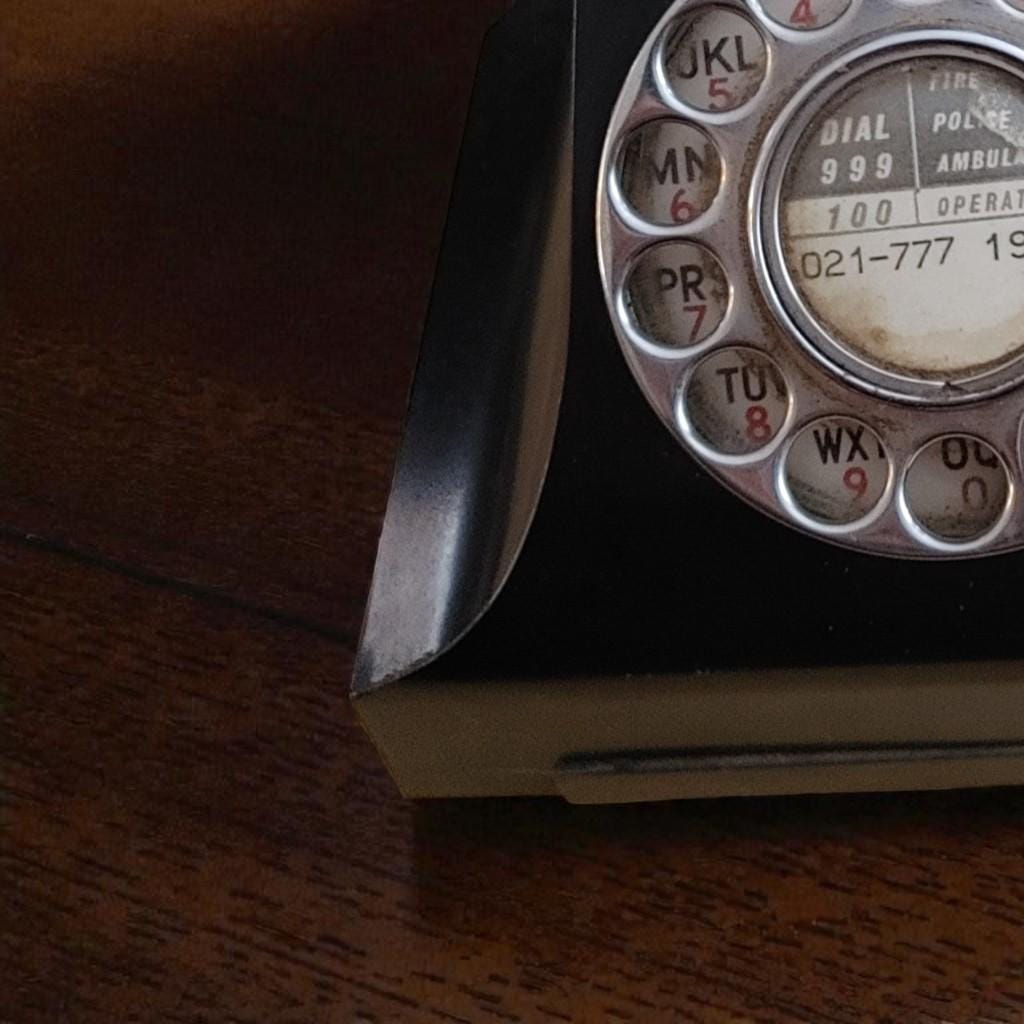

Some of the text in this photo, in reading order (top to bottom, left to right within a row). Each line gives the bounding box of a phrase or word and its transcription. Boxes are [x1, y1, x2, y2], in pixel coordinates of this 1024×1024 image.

[676, 35, 758, 79] JKL
[708, 78, 734, 110] 5
[929, 71, 978, 92] FIRE
[820, 113, 890, 146] DIAL
[820, 152, 893, 185] 999
[670, 188, 700, 224] 6
[828, 199, 892, 230] 100
[801, 236, 955, 280] 021-777
[683, 304, 707, 342] 7
[746, 405, 772, 443] 8
[842, 466, 869, 500] 9
[961, 476, 988, 510] 0
